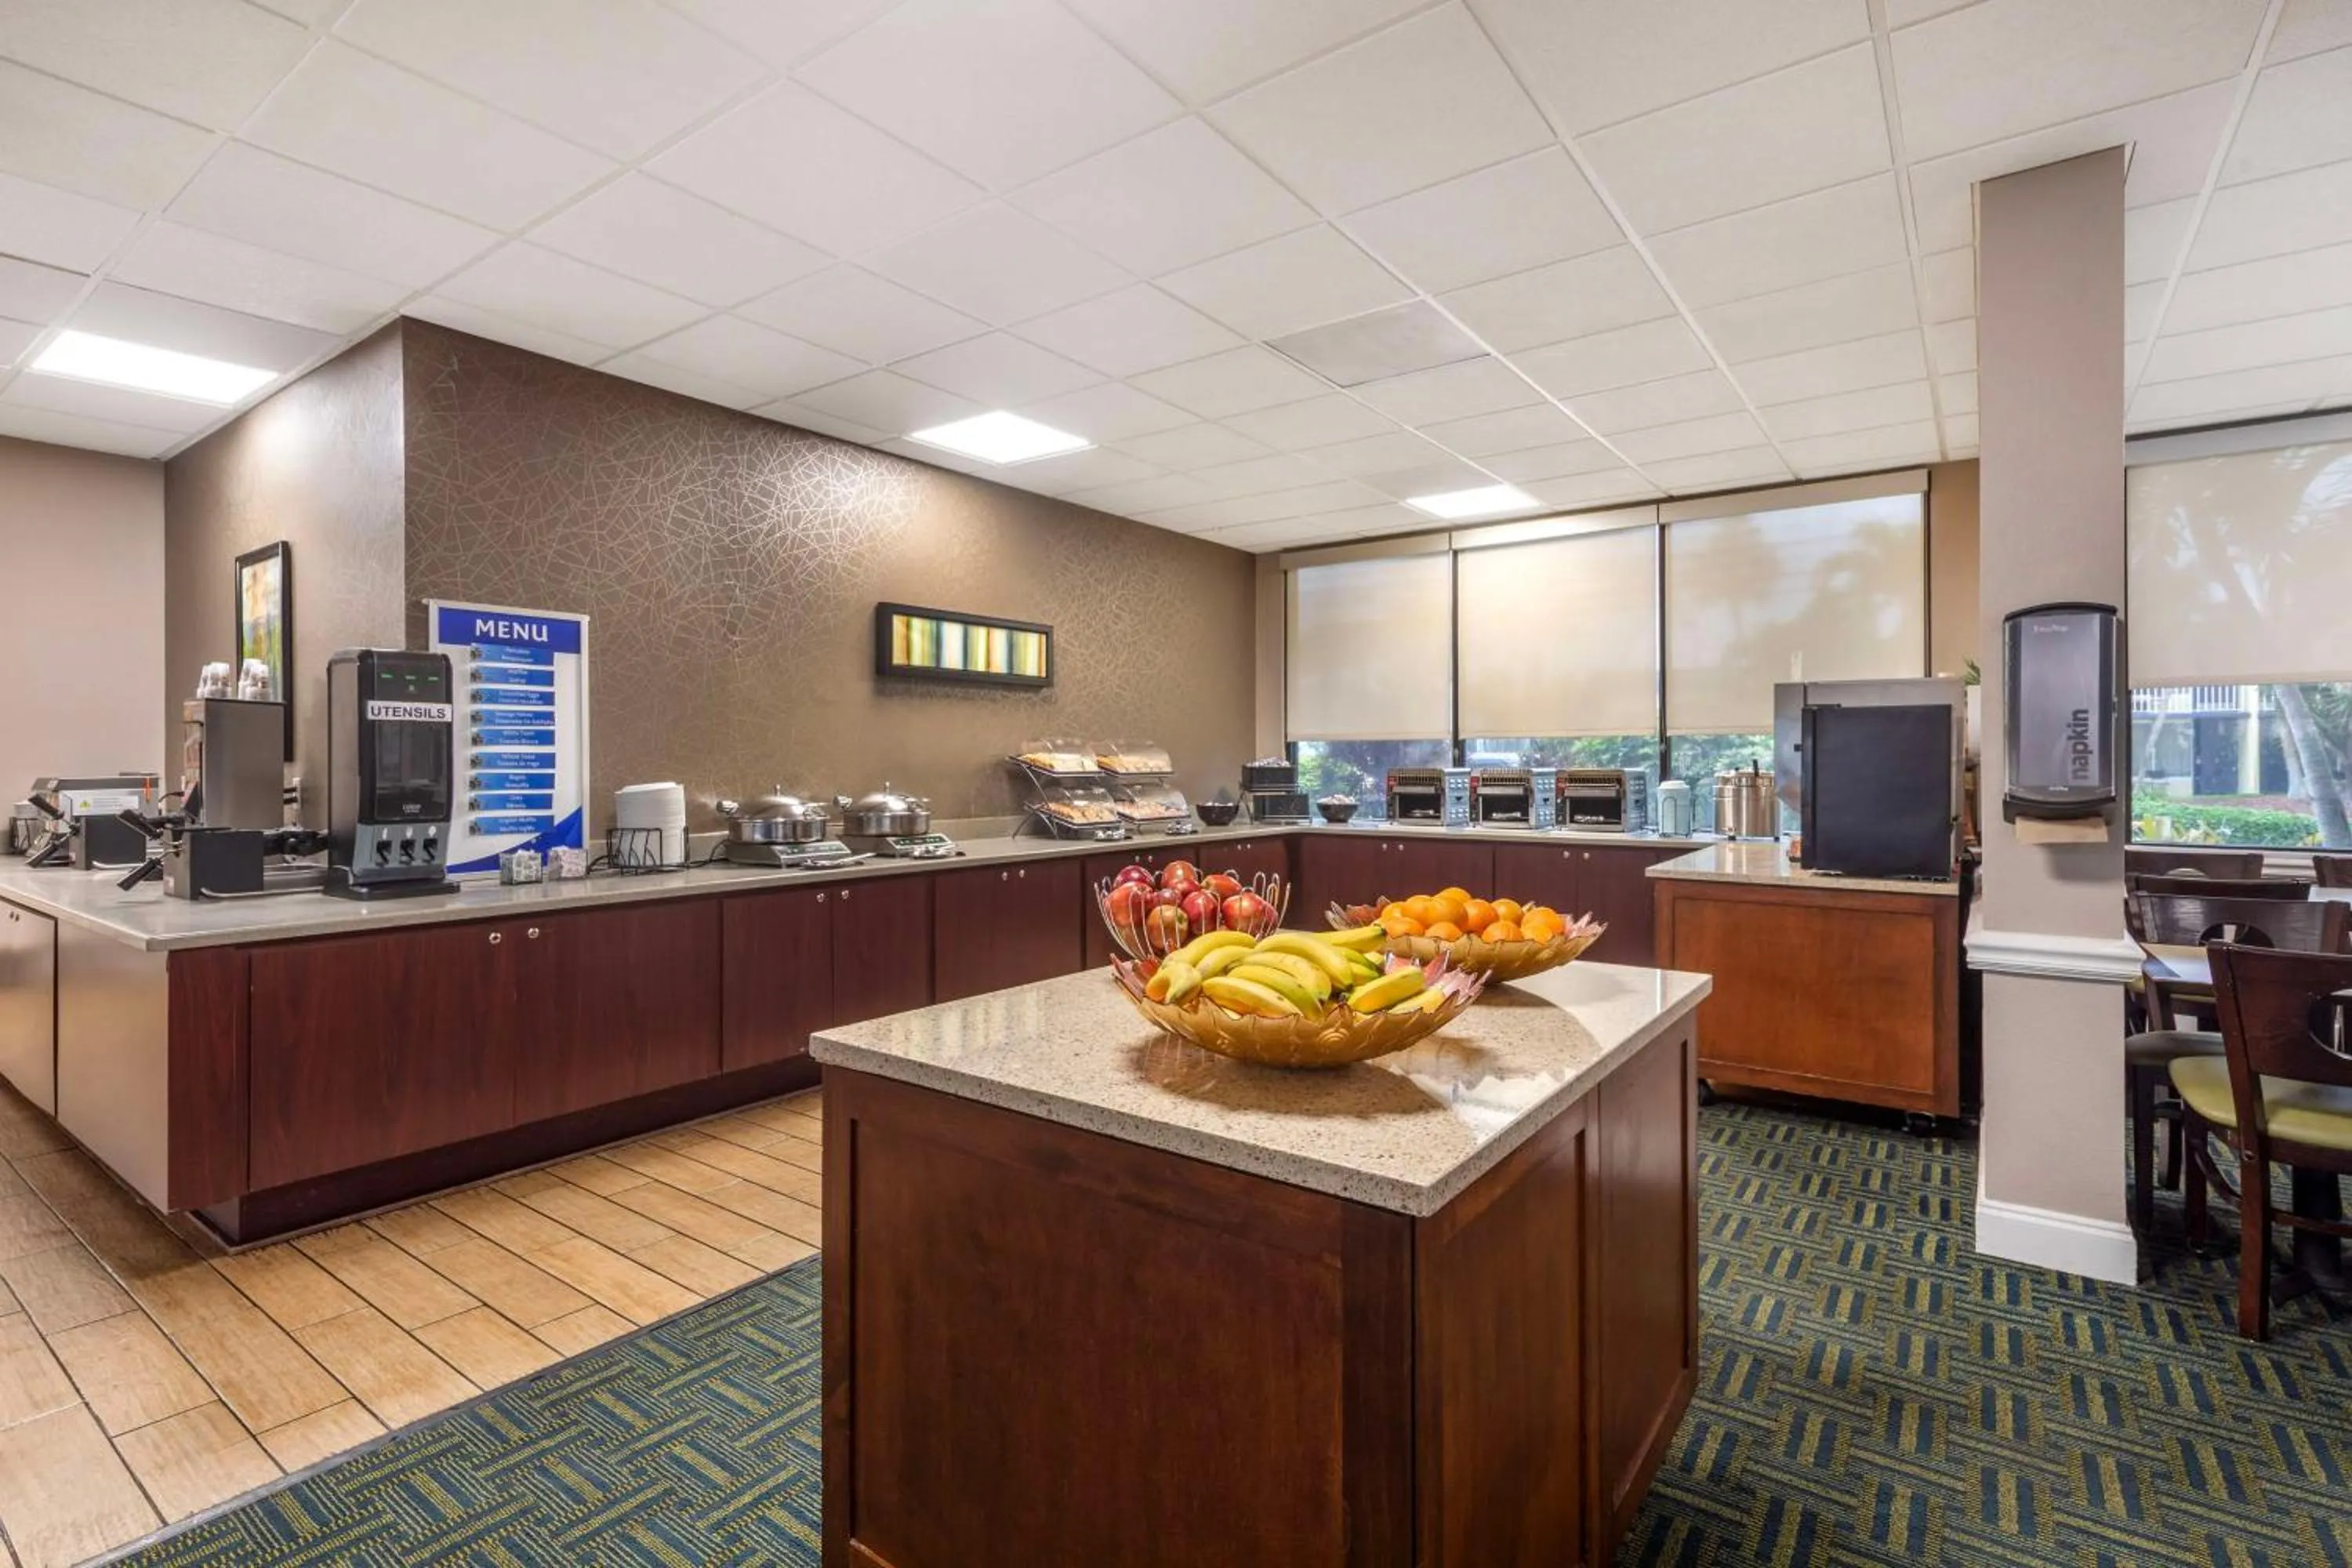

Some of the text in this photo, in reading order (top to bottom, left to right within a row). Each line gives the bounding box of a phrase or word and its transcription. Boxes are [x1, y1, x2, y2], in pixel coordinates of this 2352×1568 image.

[476, 619, 548, 642] MENU
[371, 706, 446, 719] UTENSILS
[2066, 709, 2093, 780] napkin
